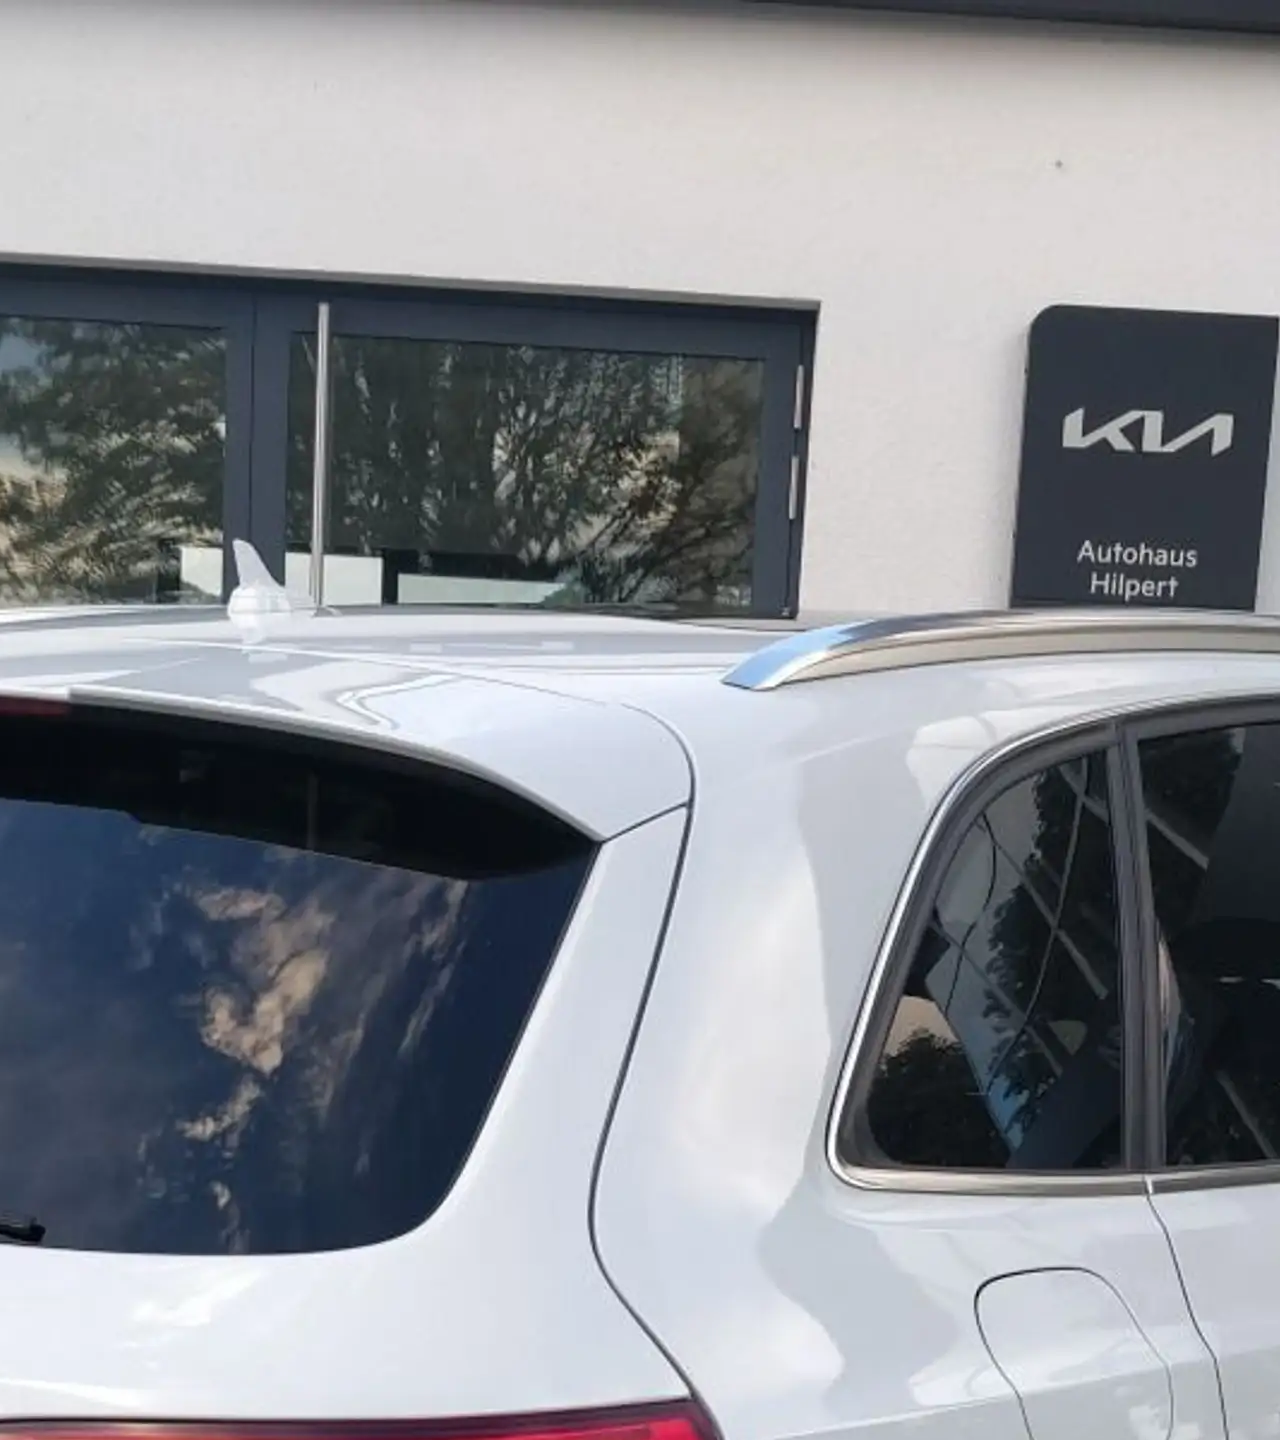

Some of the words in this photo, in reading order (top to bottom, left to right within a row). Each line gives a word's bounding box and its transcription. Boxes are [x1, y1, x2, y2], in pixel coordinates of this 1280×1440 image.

[1062, 407, 1234, 456] KIA
[1077, 539, 1198, 567] Autohaus
[1090, 571, 1179, 601] Hilpert
